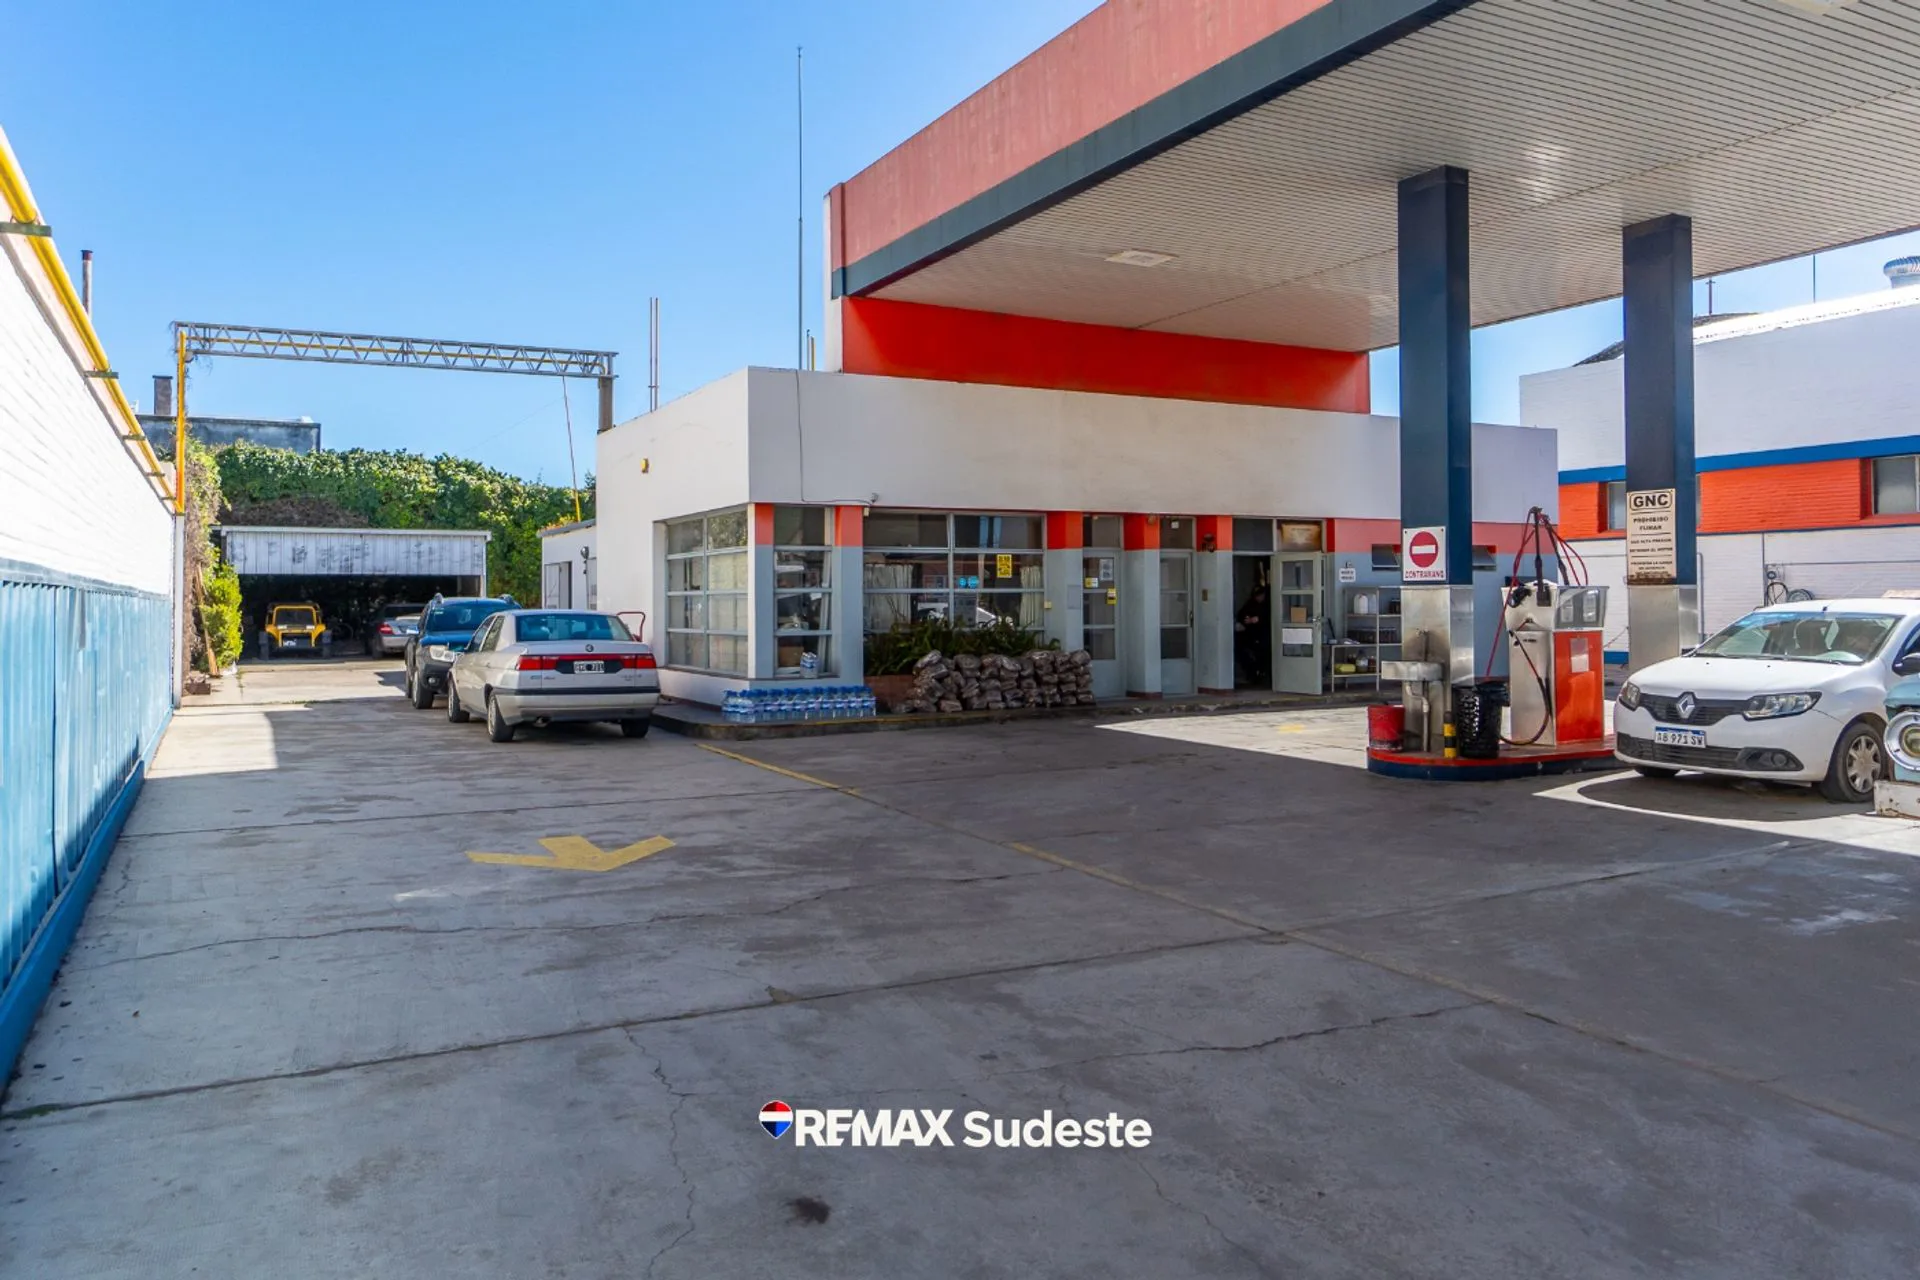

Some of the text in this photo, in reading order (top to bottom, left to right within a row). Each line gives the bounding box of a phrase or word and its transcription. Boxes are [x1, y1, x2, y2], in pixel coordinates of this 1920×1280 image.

[1633, 494, 1668, 508] GNC
[1633, 516, 1669, 524] PROHIBIDO
[1404, 570, 1444, 579] CONTRAMANO
[1671, 733, 1688, 744] 971
